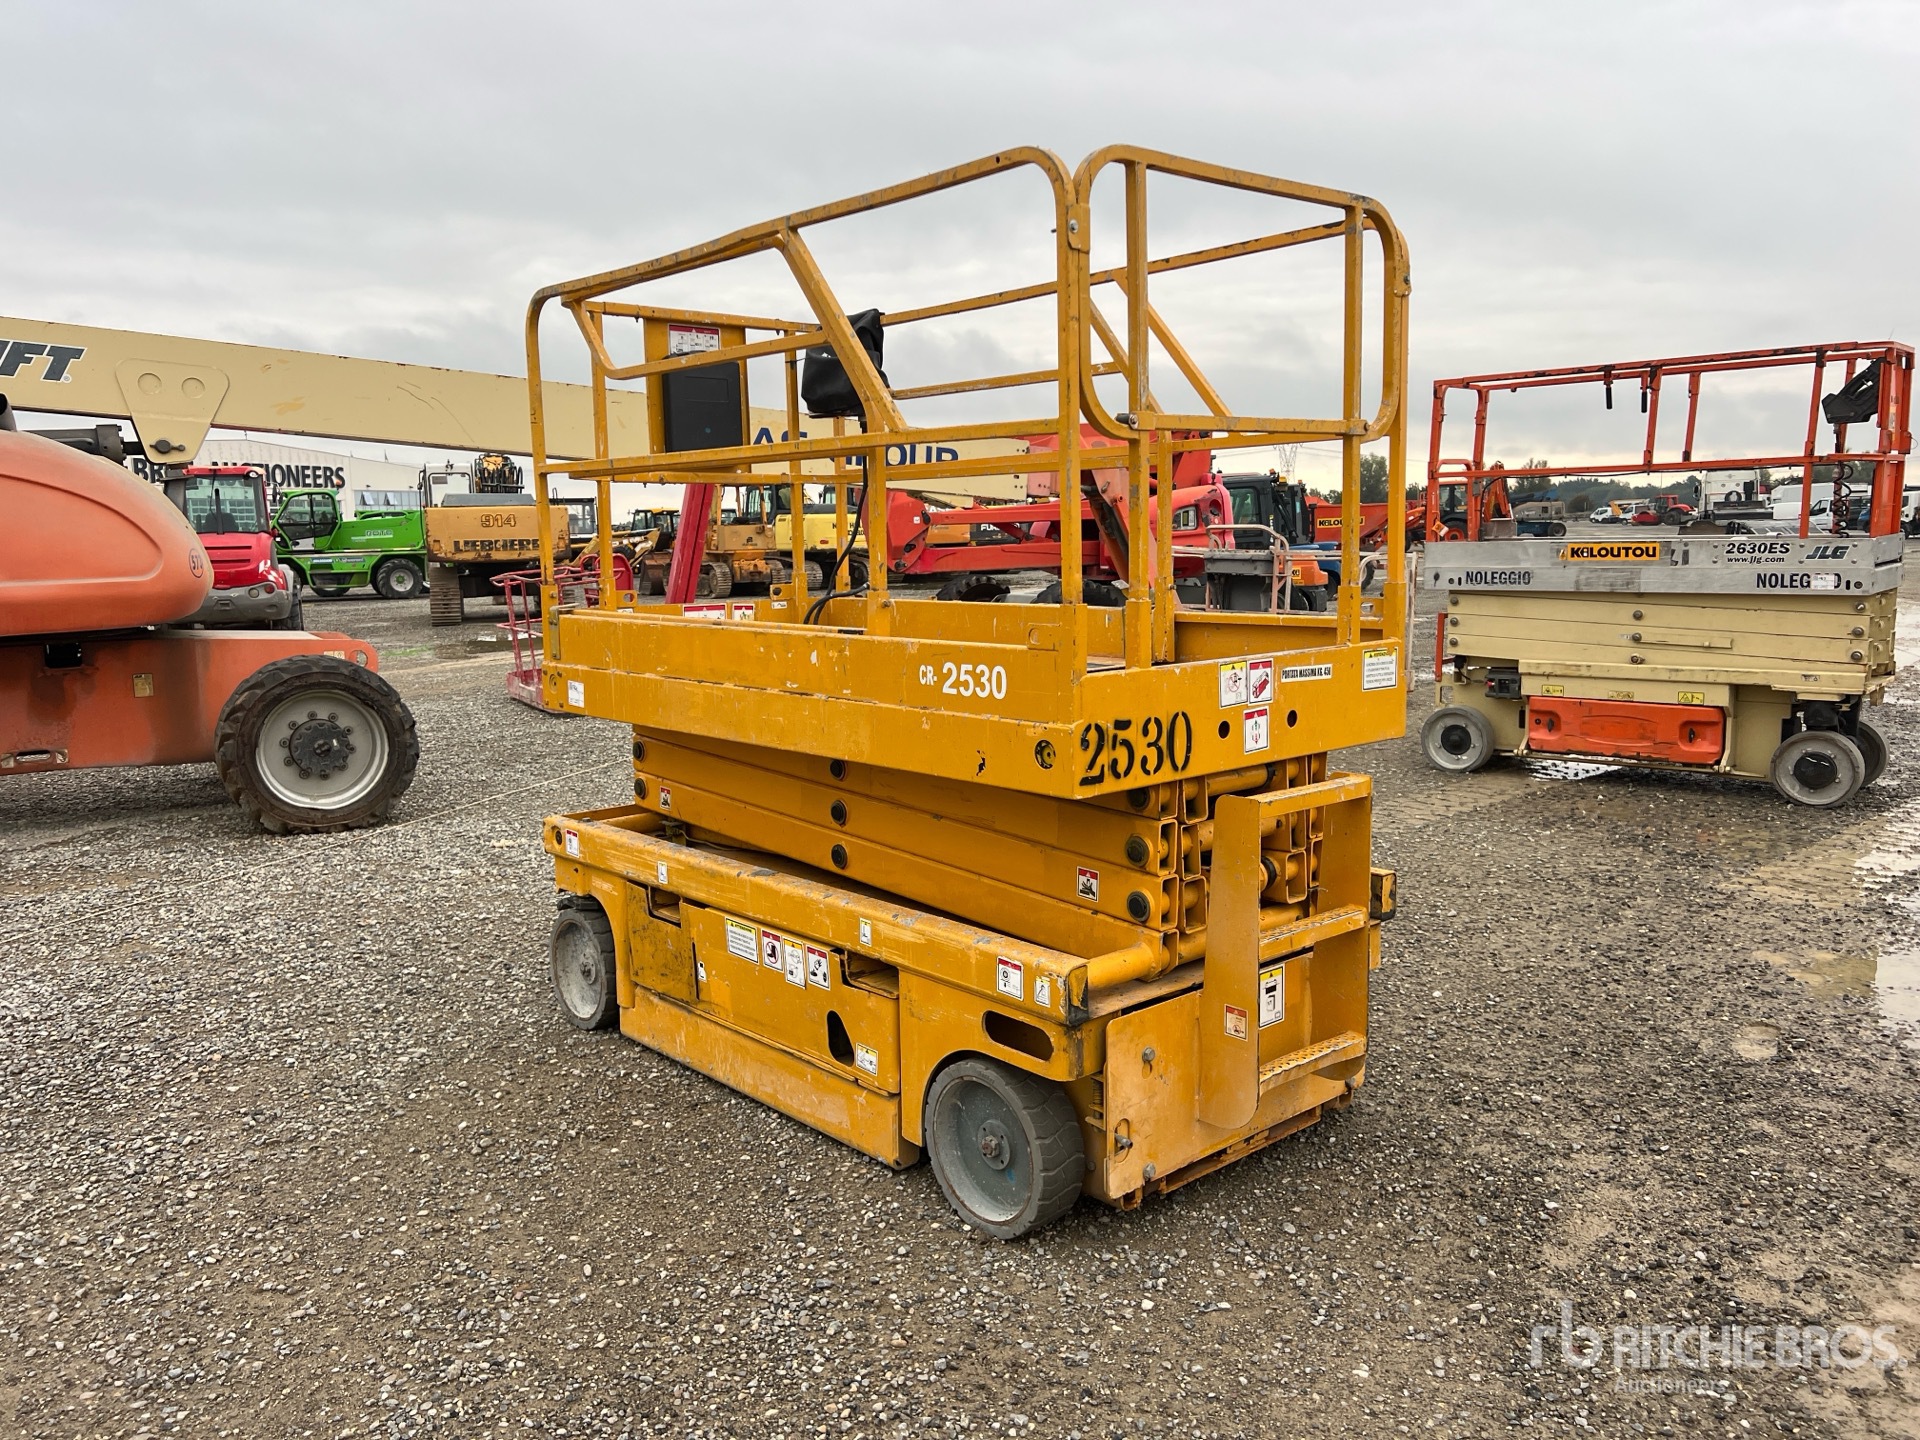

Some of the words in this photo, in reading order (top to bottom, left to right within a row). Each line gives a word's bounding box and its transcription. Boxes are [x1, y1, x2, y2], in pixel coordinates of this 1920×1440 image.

[481, 513, 517, 528] 914
[1725, 543, 1790, 554] 2630ES
[1805, 546, 1850, 560] JLG
[1727, 555, 1785, 565] www.jlg.com
[1465, 571, 1531, 586] NOLEGGIO
[1756, 572, 1842, 590] NOLEGO
[942, 661, 1007, 700] 2530
[1079, 710, 1192, 787] 2530
